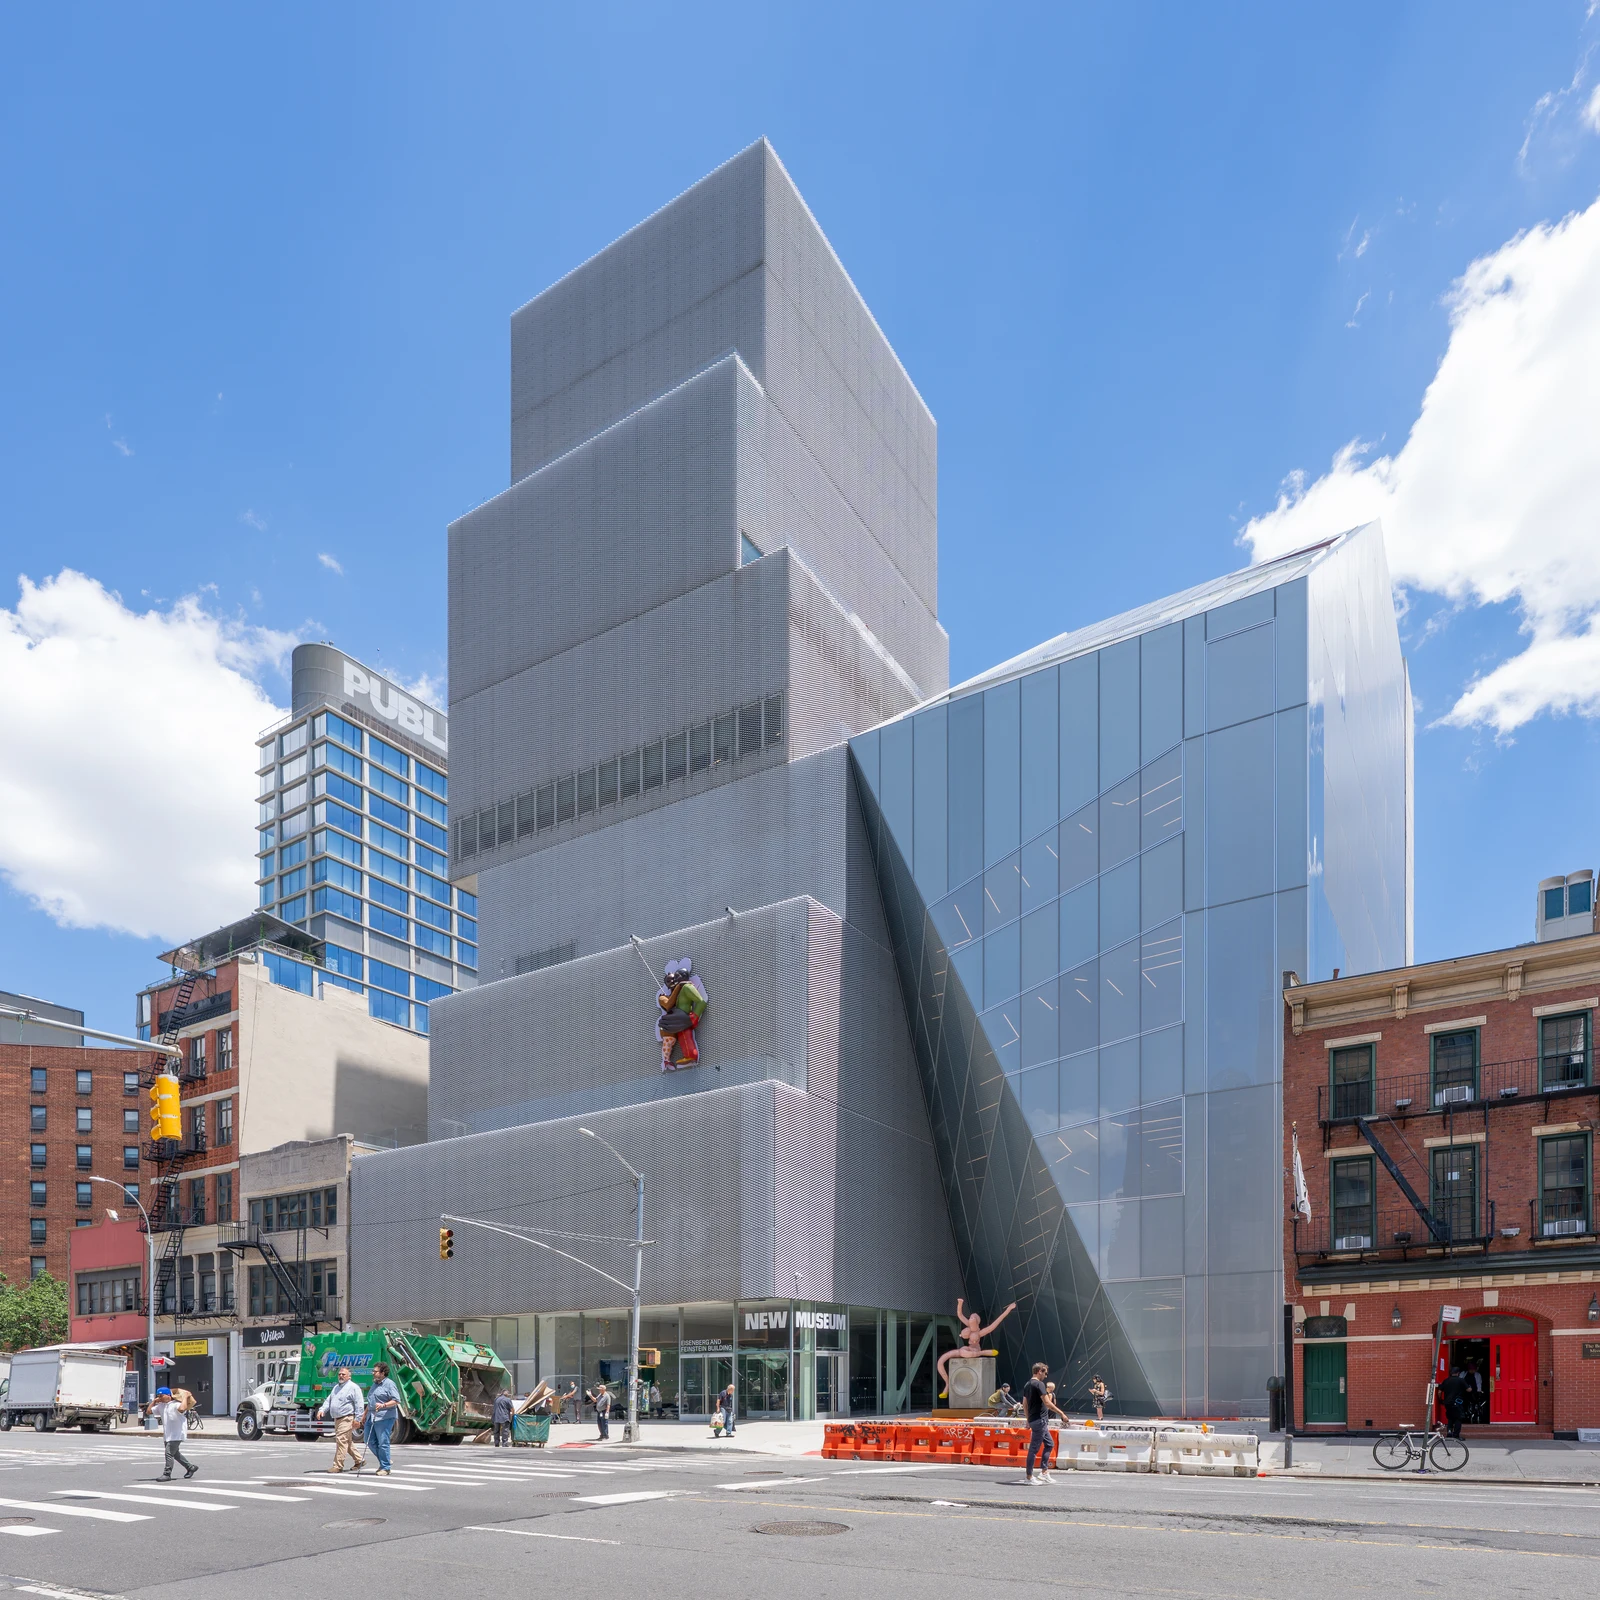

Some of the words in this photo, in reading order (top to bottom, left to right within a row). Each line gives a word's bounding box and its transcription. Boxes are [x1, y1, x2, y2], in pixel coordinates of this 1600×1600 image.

[343, 660, 448, 752] PUBL
[745, 1311, 788, 1331] NEW
[795, 1310, 846, 1331] MUSEUM
[680, 1339, 710, 1347] EISENBERG
[680, 1345, 707, 1353] FEINSTEIN
[707, 1344, 733, 1352] BUILDING
[324, 1351, 374, 1367] PLANET
